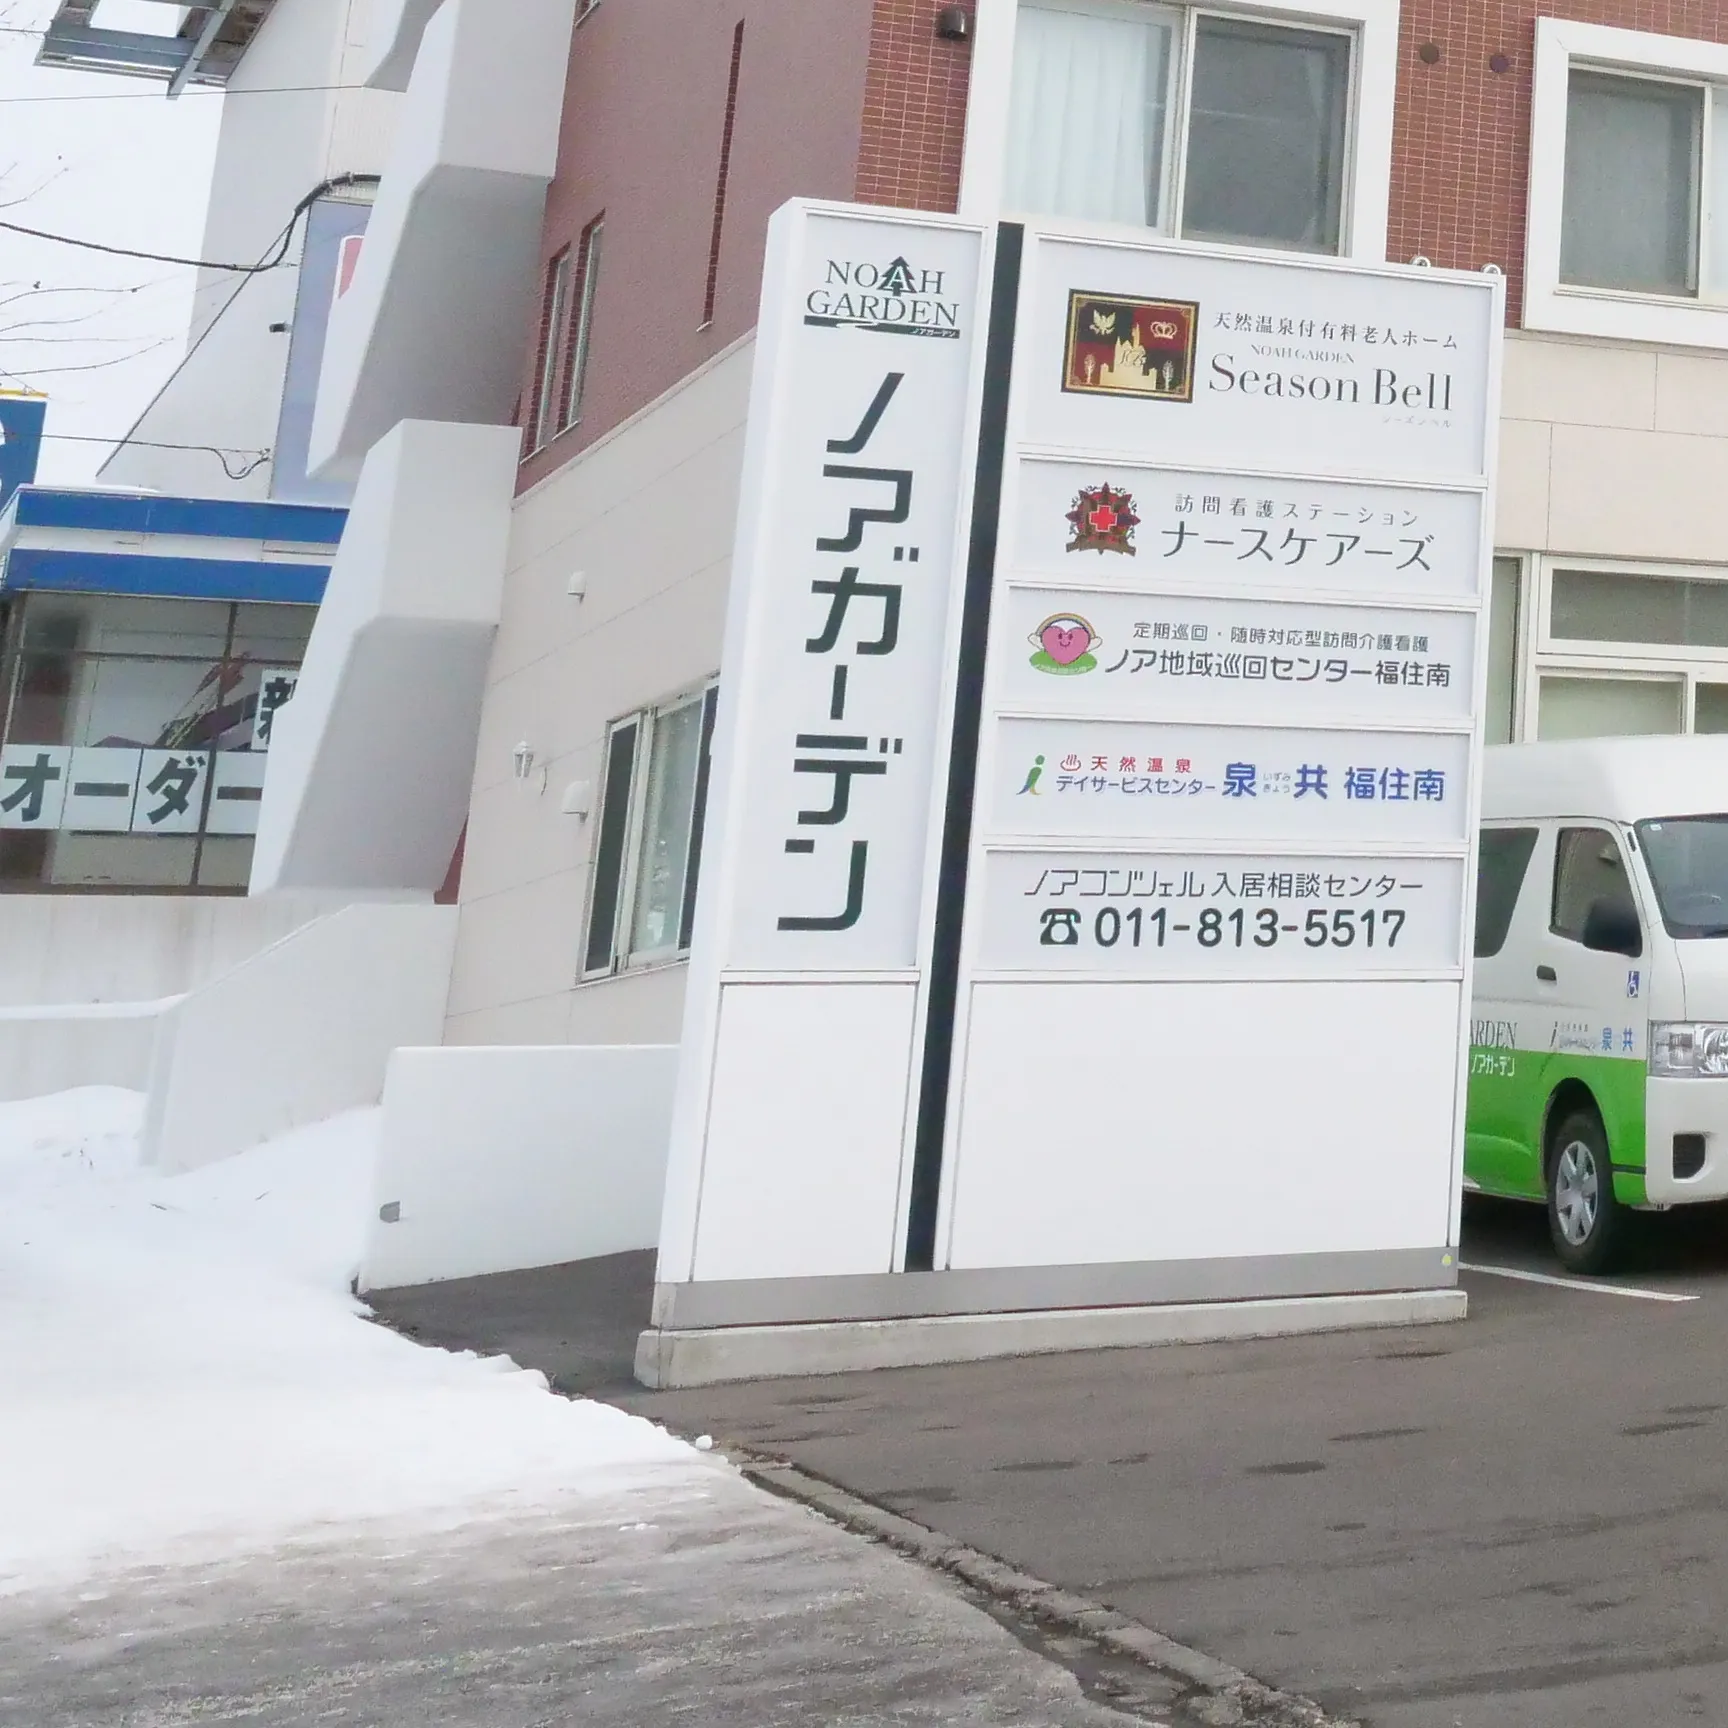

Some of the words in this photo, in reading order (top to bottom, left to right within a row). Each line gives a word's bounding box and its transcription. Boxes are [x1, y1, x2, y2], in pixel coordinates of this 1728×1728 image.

[825, 256, 945, 295] NOAH
[807, 289, 960, 327] GARDEN
[1214, 312, 1458, 350] 天然温泉付有料老人ホーム
[1250, 344, 1292, 358] NOAH
[1294, 348, 1355, 364] GARDEN
[1209, 353, 1359, 404] Season
[1373, 368, 1453, 411] Bell
[1174, 492, 1419, 527] 訪問看護ステーション
[1160, 520, 1435, 572] ナースケアーズ
[776, 371, 920, 932] ノアガーデン
[1104, 648, 1451, 688] ノア地域巡回センター福住南
[1056, 773, 1216, 796] デイサービスセンター
[1344, 764, 1446, 802] 福住南
[1090, 755, 1192, 773] 天然温泉
[1095, 906, 1406, 949] 011-813-5517
